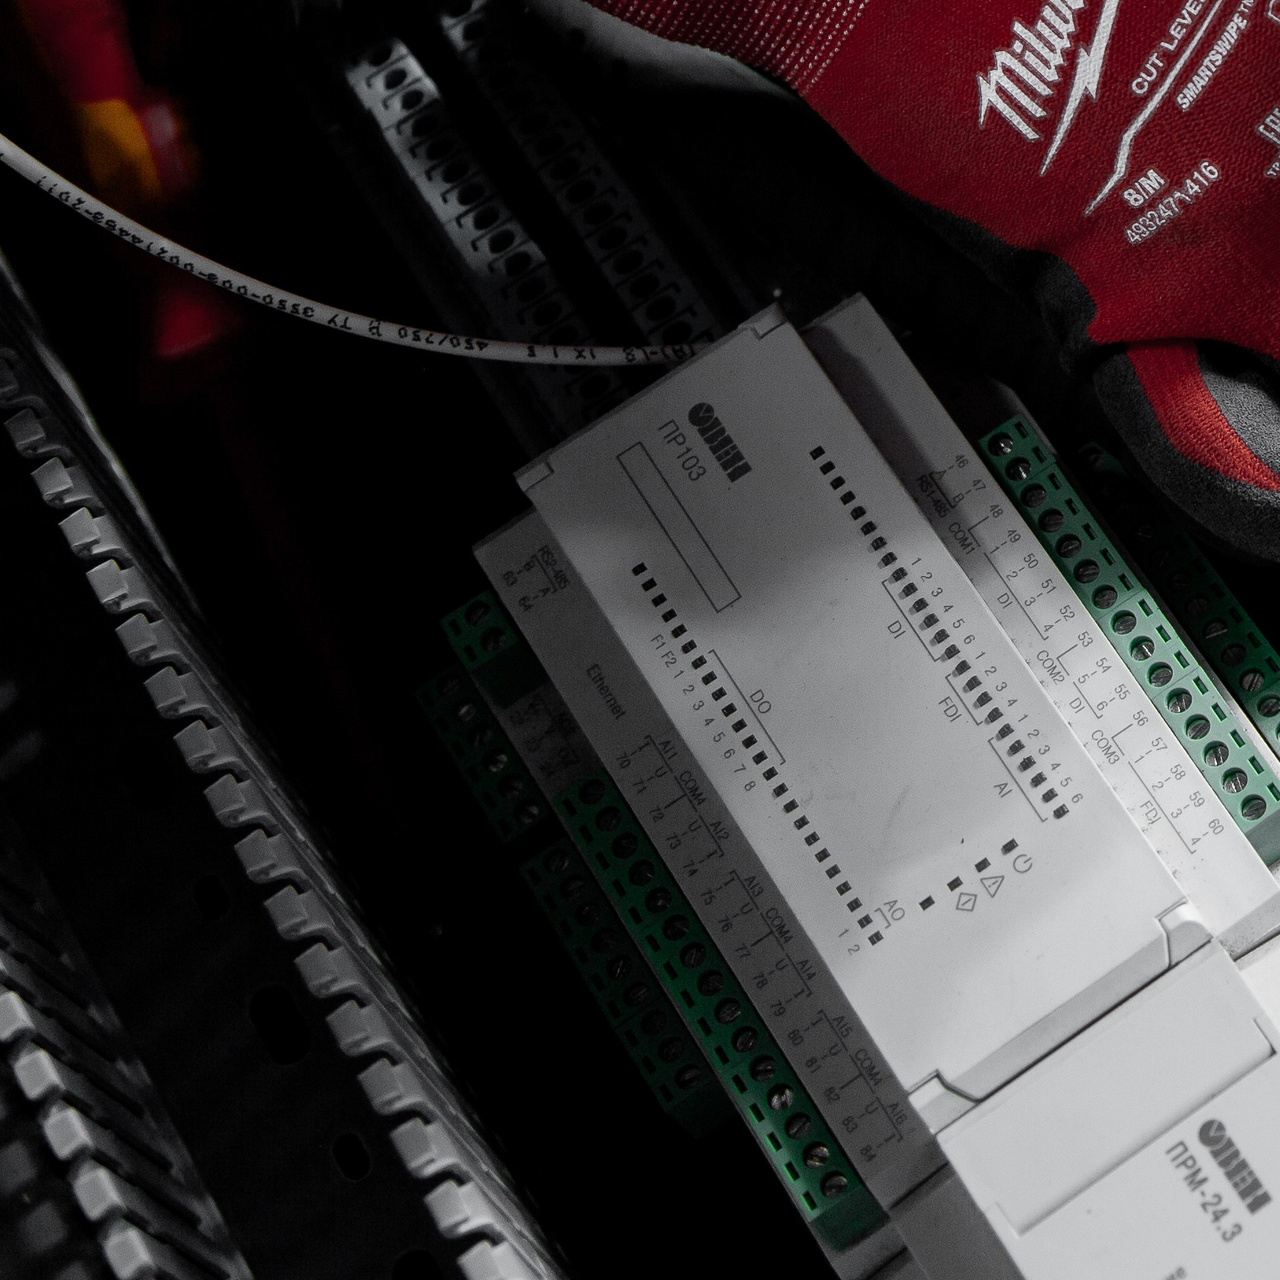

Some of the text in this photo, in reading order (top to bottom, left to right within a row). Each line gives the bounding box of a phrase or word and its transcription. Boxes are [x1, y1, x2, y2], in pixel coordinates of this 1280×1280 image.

[1131, 52, 1164, 96] CUT
[1123, 168, 1166, 207] 8/M
[1125, 161, 1219, 243] 4932471416
[658, 419, 707, 481] ПР103
[887, 620, 906, 639] DI
[650, 633, 677, 668] F1 F2
[586, 663, 627, 721] Ethernet
[948, 522, 1162, 825] COM1 DI COM2 DI COM3 FDI
[1007, 529, 1224, 835] 49 50 51 52 53 54 55 56 57 58 59 60
[749, 689, 772, 714] DO
[938, 696, 962, 723] FDI
[993, 782, 1013, 798] AI
[883, 899, 905, 921] AO
[1166, 1140, 1242, 1242] ПРМ-24.3
